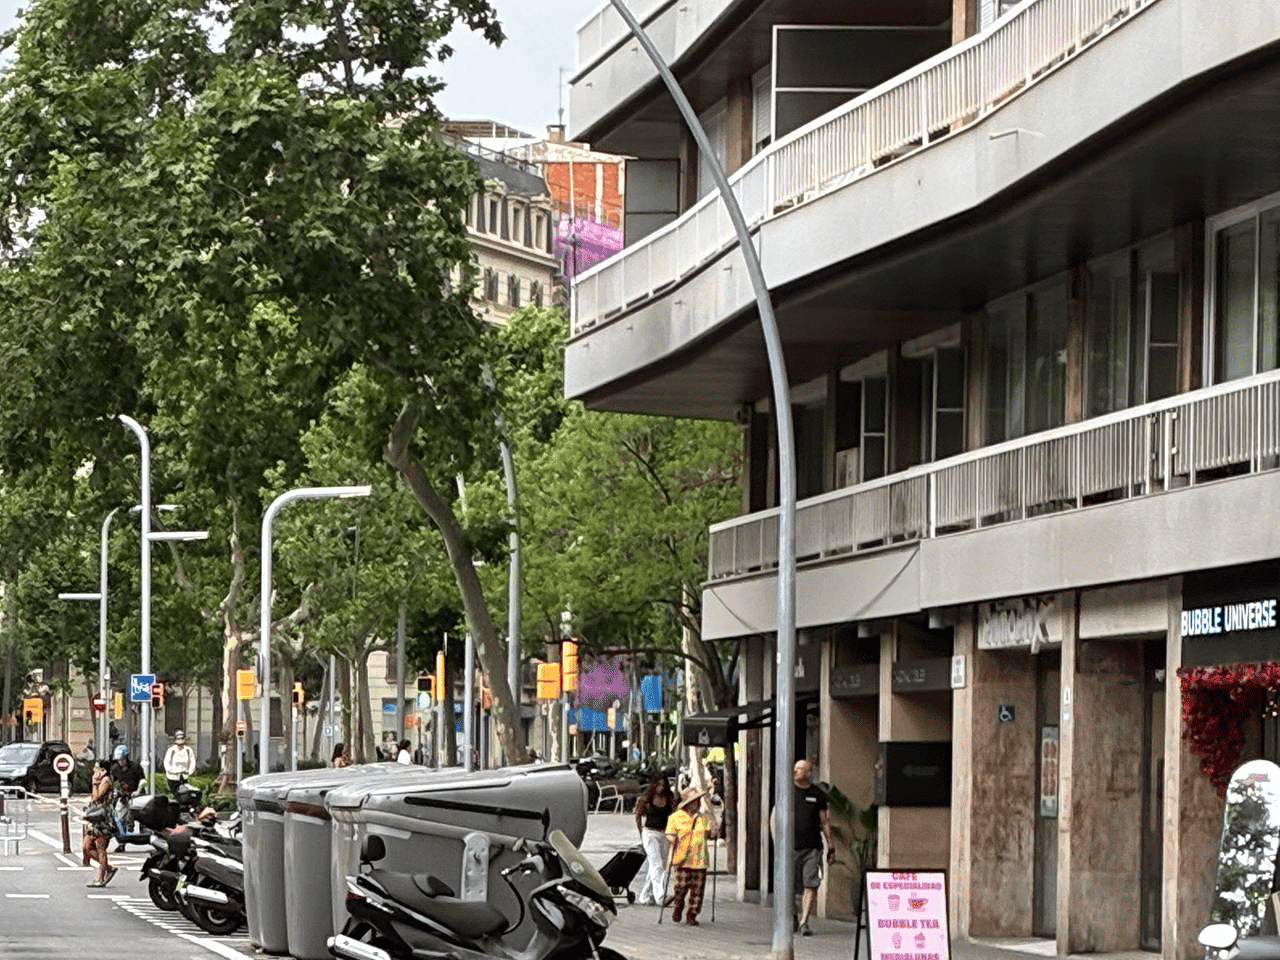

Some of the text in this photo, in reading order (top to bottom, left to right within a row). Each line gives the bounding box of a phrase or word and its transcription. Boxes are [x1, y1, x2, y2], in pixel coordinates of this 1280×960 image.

[1180, 599, 1277, 637] BUBBLE UNIVERSE
[877, 919, 940, 929] BUBBLE TEA
